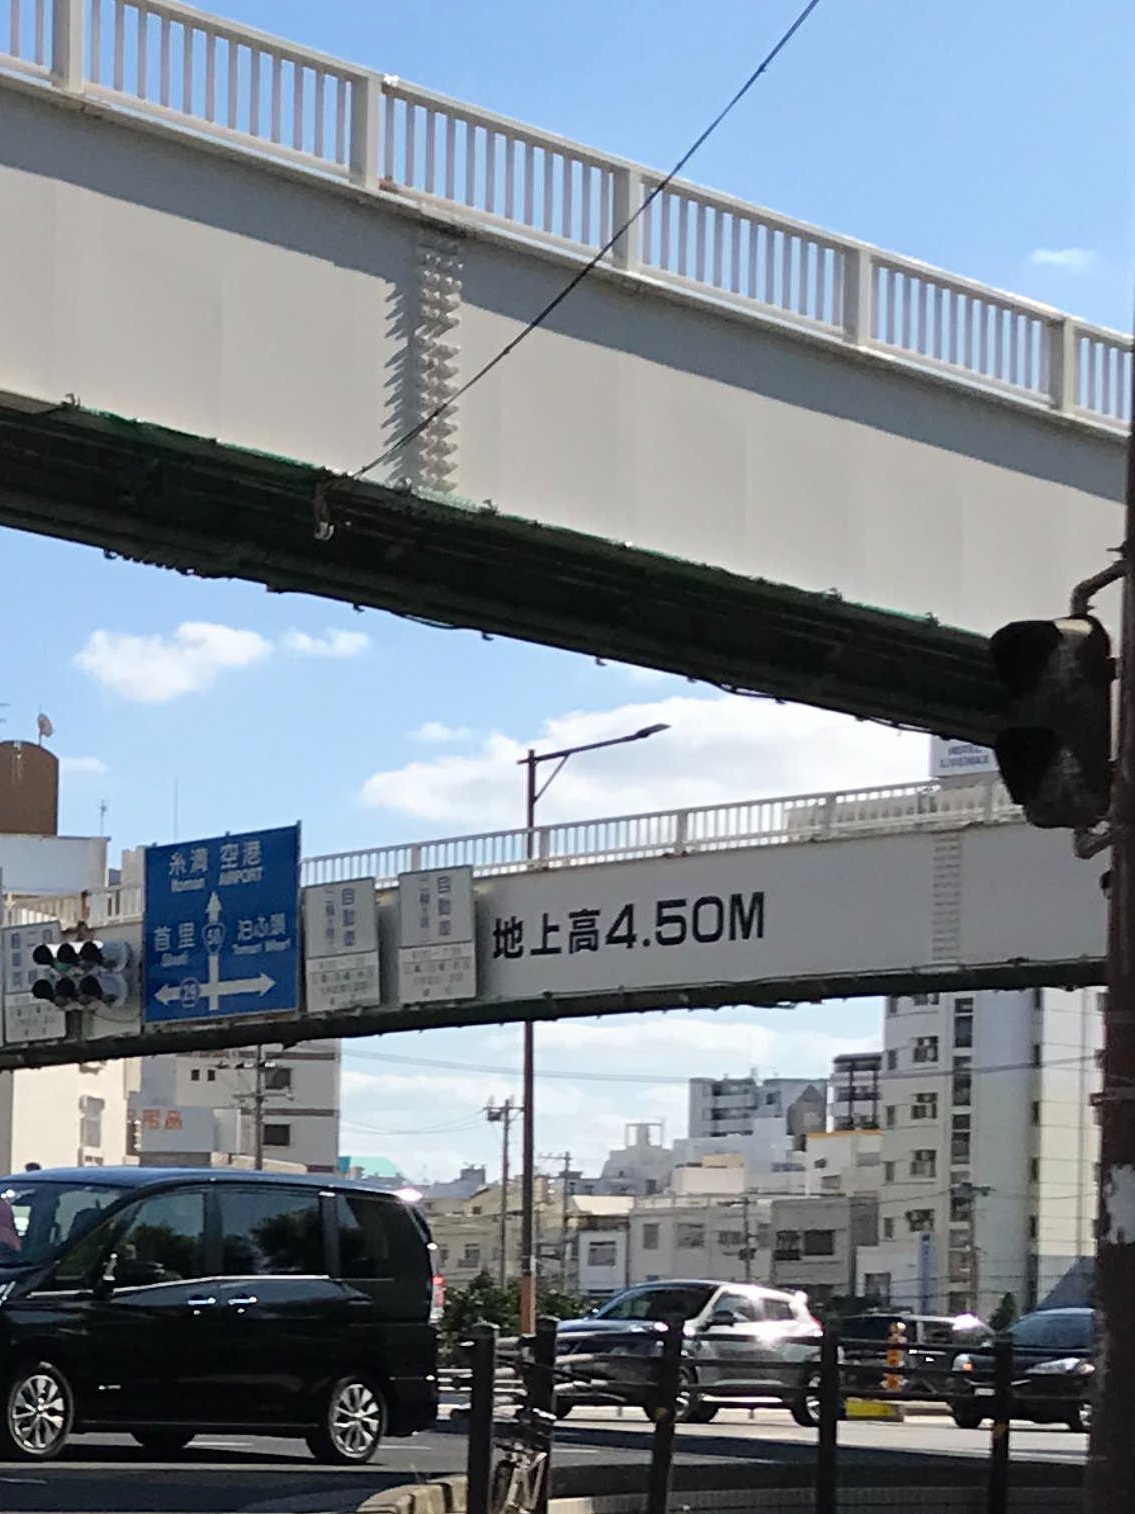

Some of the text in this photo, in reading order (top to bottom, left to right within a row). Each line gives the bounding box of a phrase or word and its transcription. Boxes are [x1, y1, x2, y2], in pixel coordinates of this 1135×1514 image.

[220, 840, 262, 869] 空港
[218, 866, 263, 886] AIRPORT
[153, 921, 196, 952] 首里
